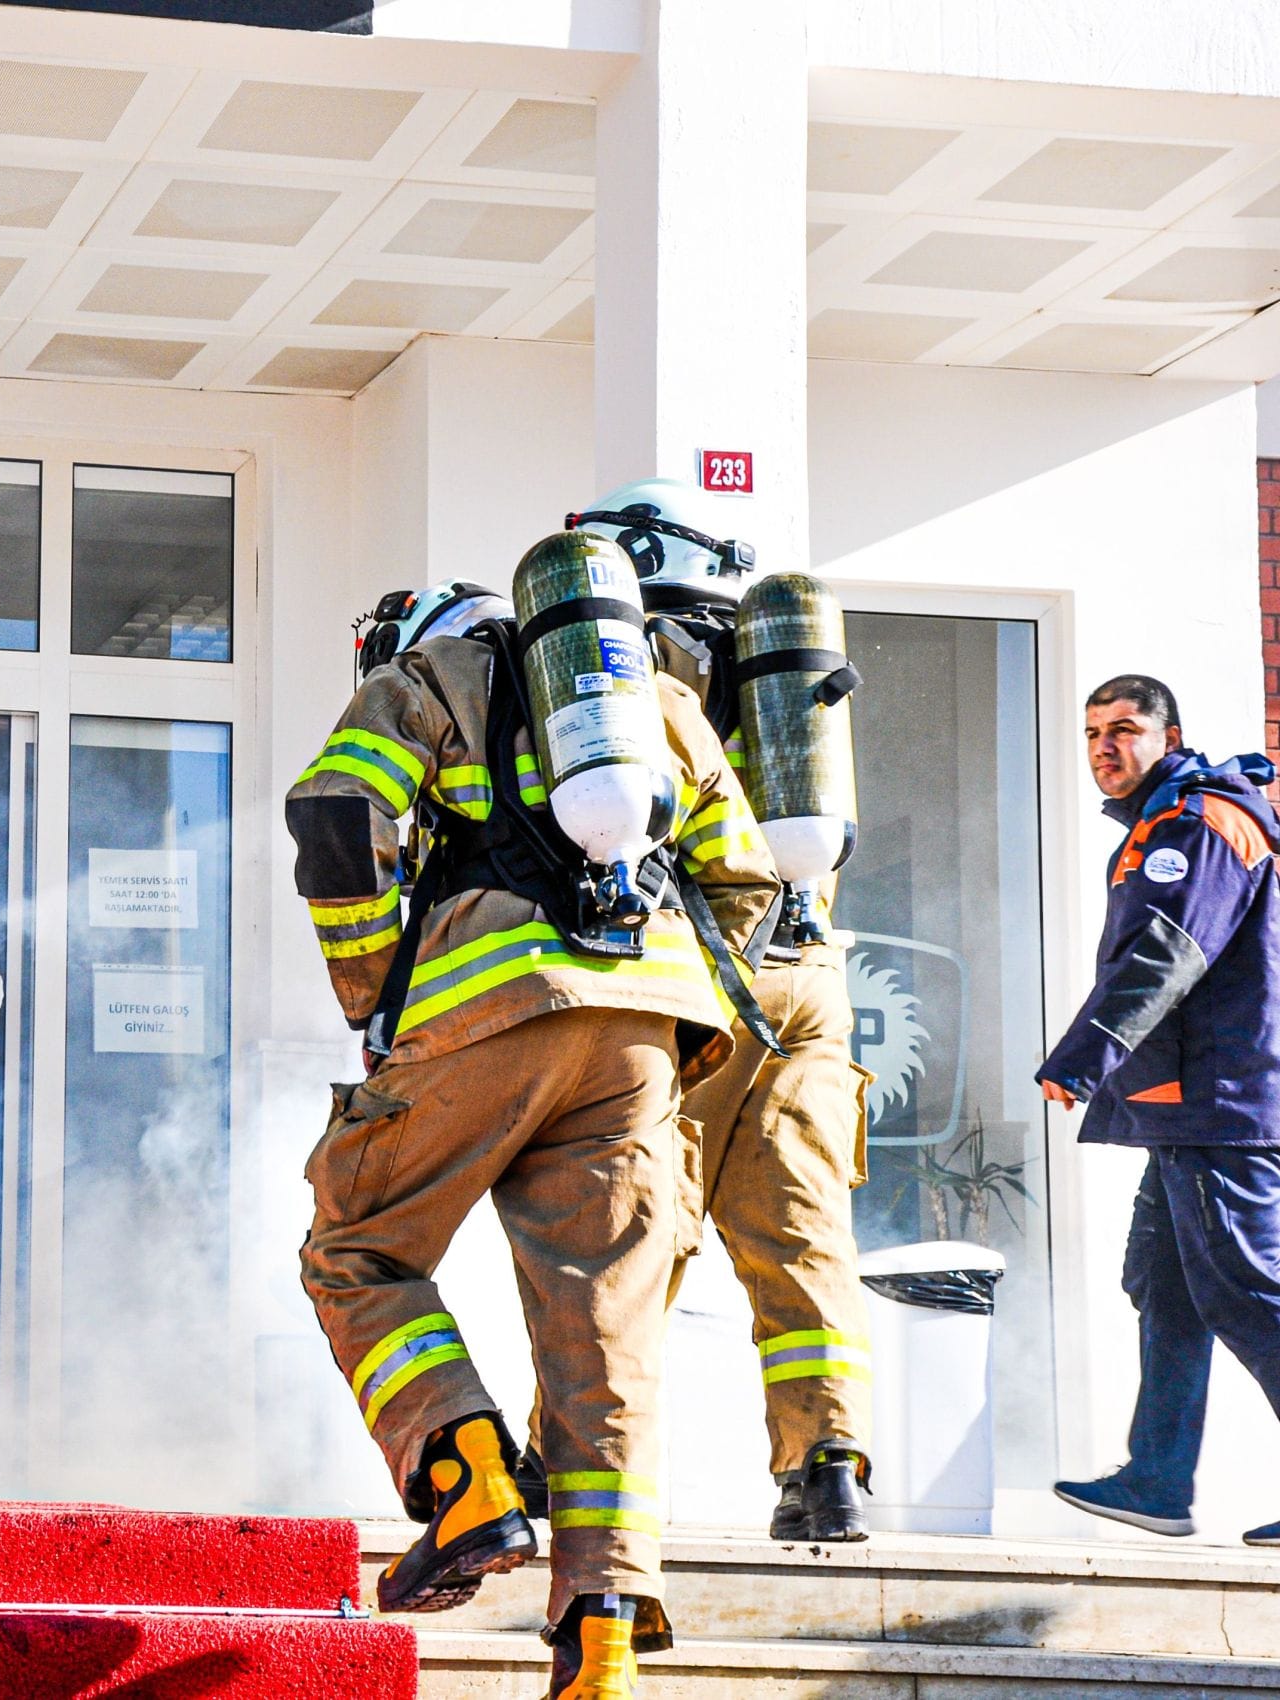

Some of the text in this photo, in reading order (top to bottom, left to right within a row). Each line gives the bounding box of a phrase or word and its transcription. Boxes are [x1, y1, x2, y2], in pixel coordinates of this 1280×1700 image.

[710, 457, 746, 487] 233
[609, 652, 635, 667] 300
[130, 875, 161, 886] SERVİS
[110, 890, 132, 898] SAAT
[135, 890, 159, 899] 12:00
[109, 1001, 190, 1018] LÜTFEN GALOŞ
